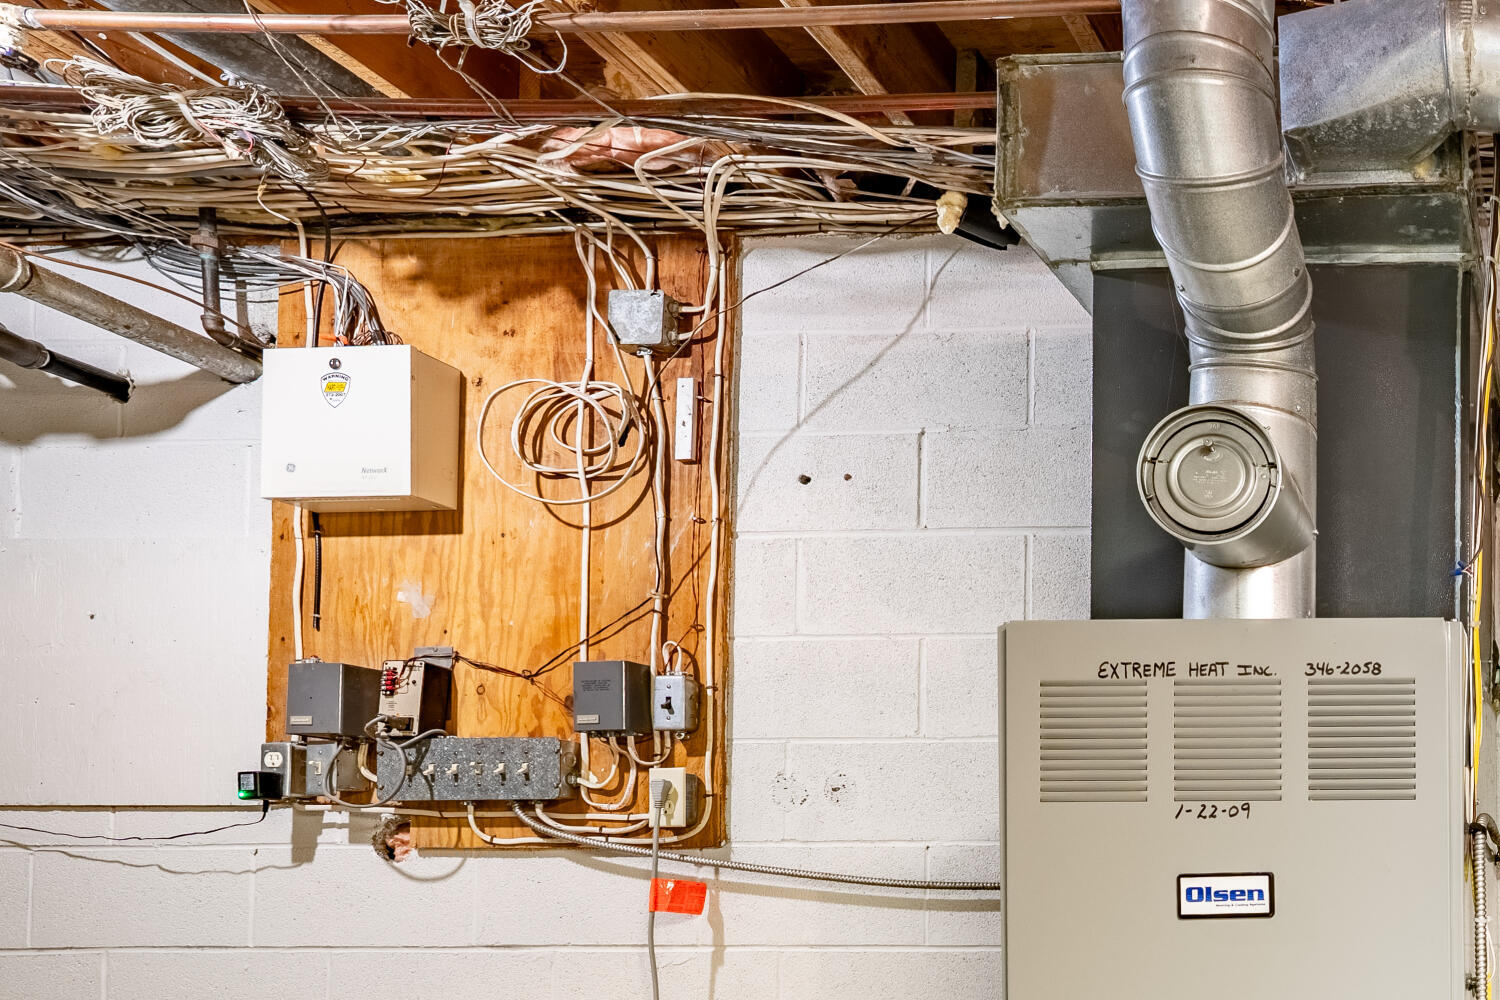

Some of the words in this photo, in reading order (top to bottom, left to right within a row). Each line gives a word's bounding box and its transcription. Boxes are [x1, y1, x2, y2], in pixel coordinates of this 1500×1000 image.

[1097, 661, 1176, 679] EXTREME
[1188, 661, 1229, 677] HEAT
[1237, 664, 1277, 677] INC.
[1304, 661, 1382, 676] 346-2058
[1174, 802, 1251, 819] 1-22-09
[1185, 886, 1265, 902] Olsen
